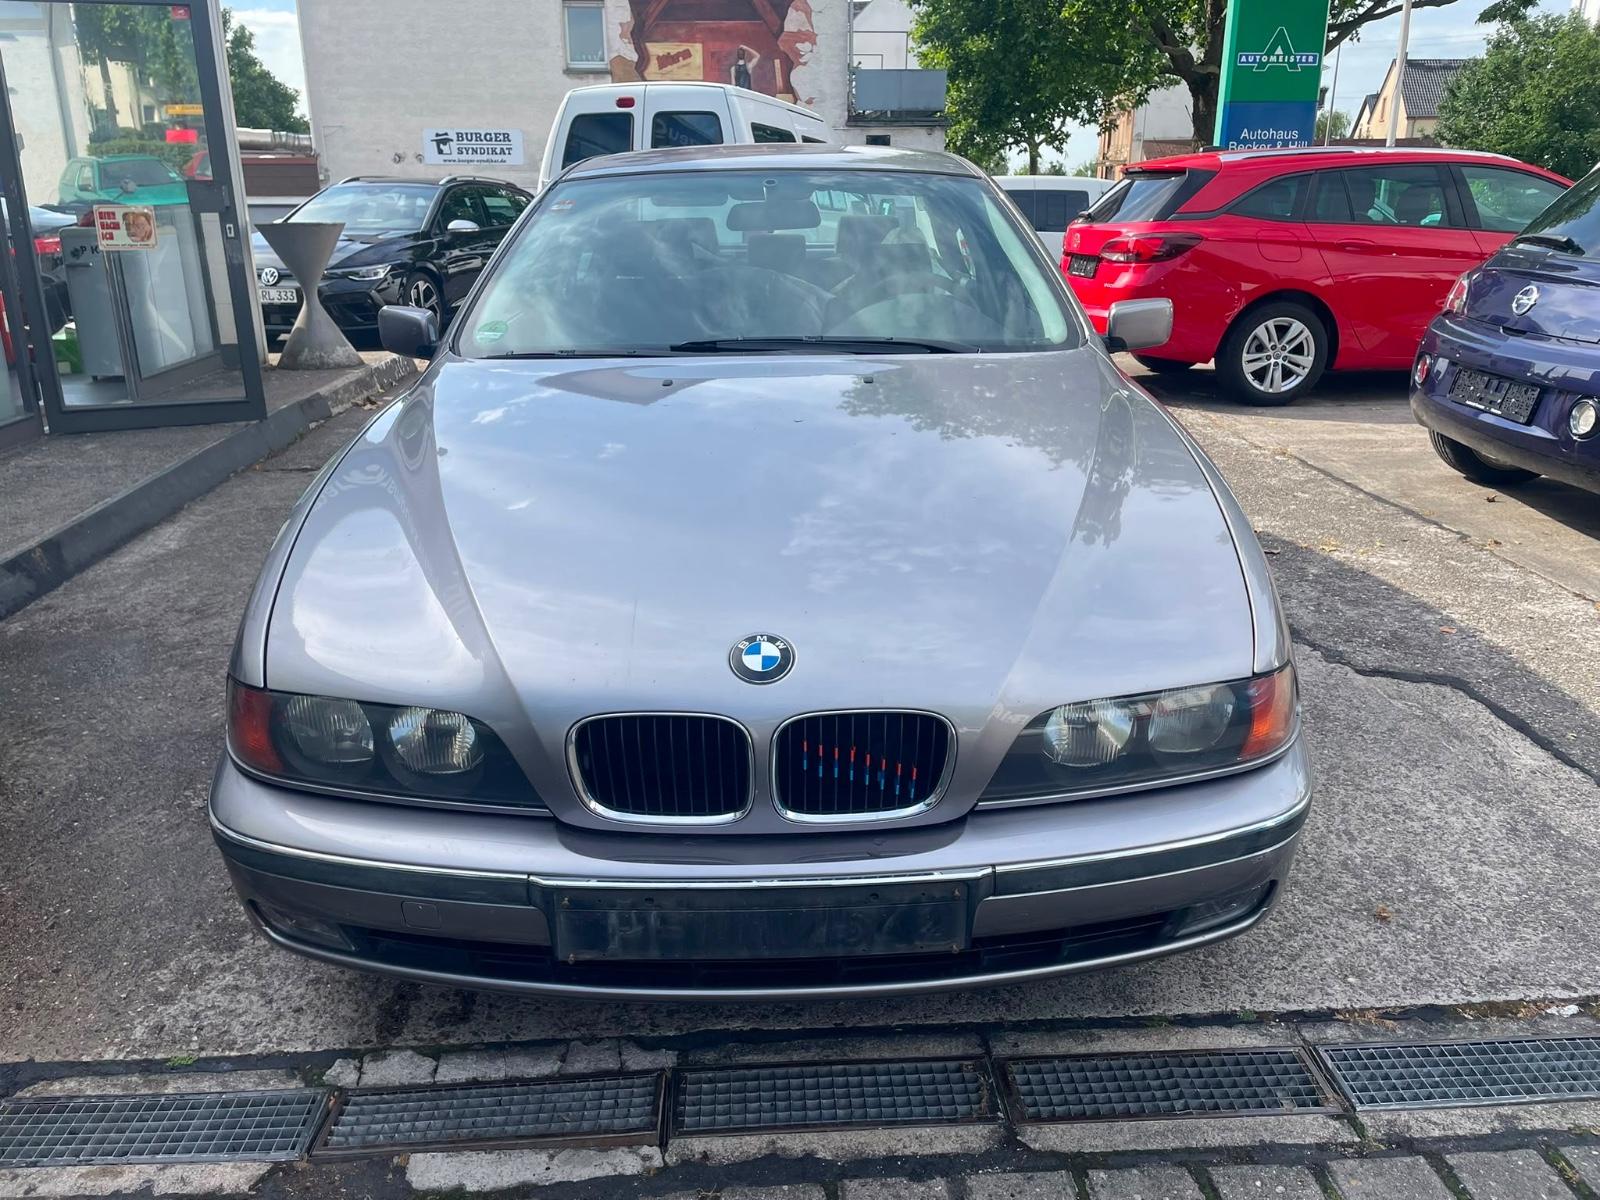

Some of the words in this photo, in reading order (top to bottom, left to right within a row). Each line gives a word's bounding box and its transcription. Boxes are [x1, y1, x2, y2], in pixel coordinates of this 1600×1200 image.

[455, 132, 511, 142] BURGER
[1240, 128, 1299, 140] Autohaus
[457, 147, 512, 156] SYNDIKAT
[261, 290, 275, 301] RL
[275, 290, 295, 301] 333
[737, 635, 788, 650] BMW
